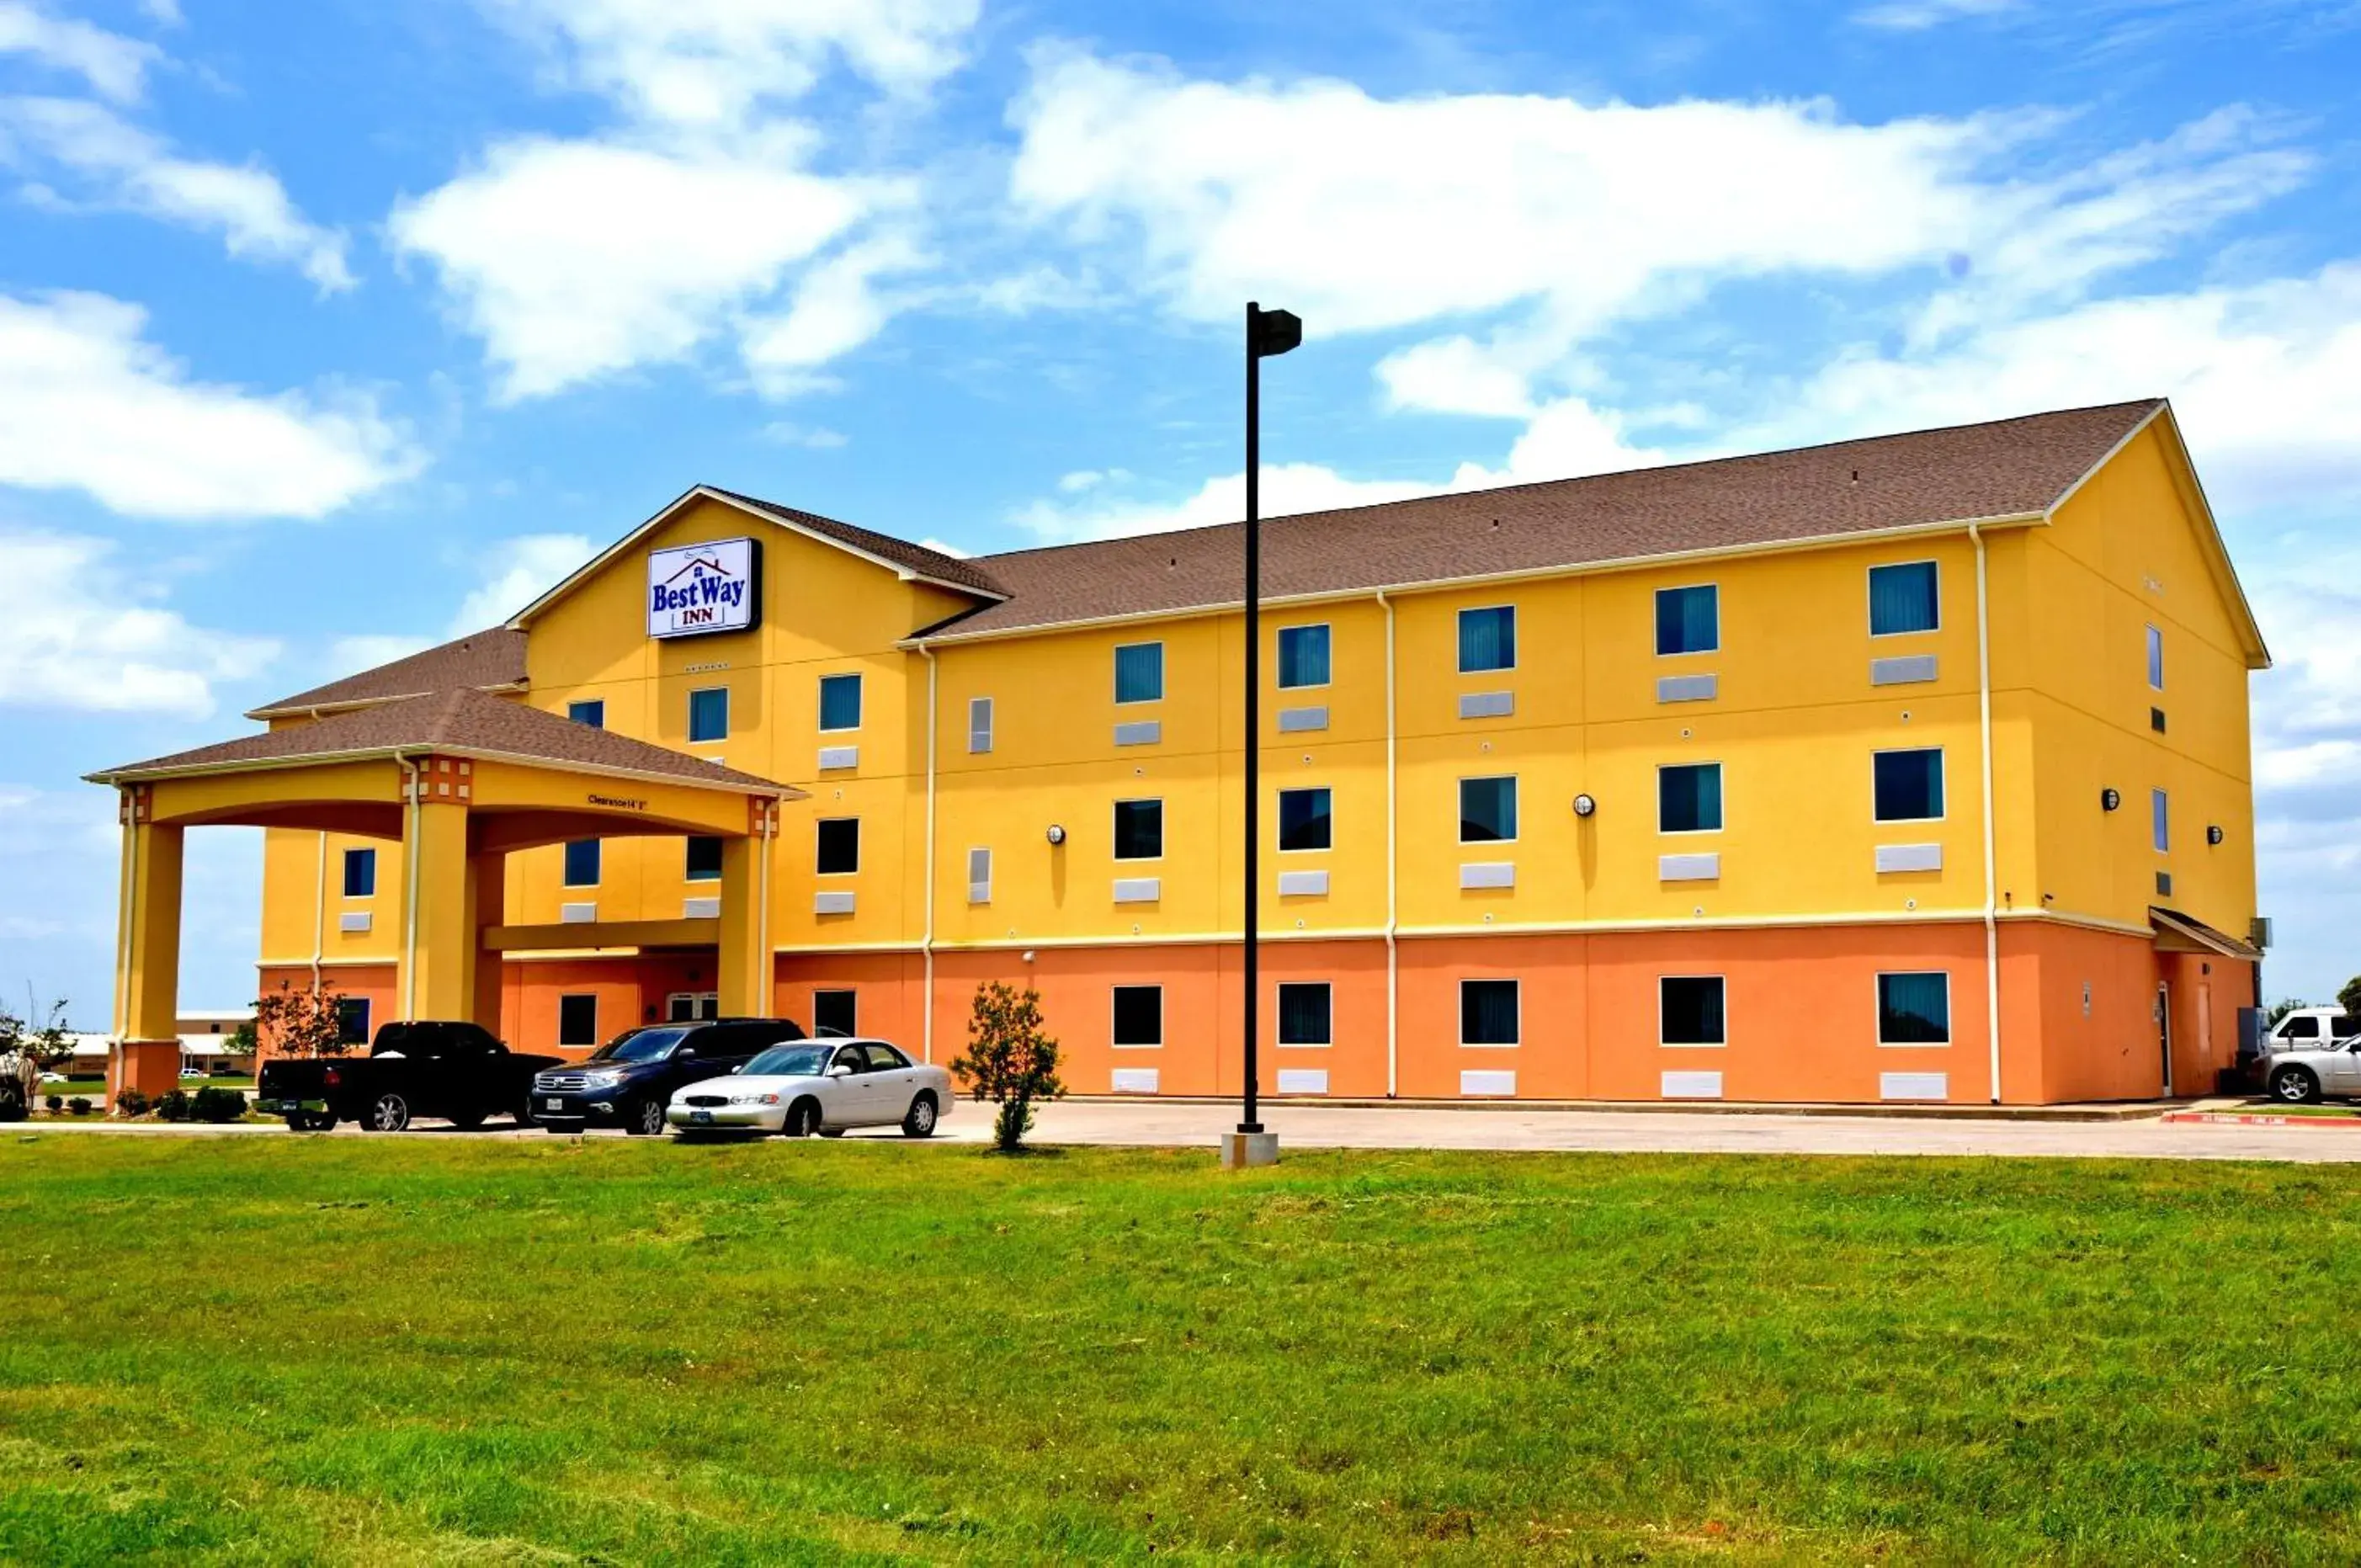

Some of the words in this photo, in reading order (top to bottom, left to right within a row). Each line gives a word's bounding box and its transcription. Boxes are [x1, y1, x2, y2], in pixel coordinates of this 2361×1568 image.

[653, 582, 698, 612] Best
[700, 576, 745, 607] Way
[683, 608, 714, 625] INN
[588, 794, 627, 807] Clearance
